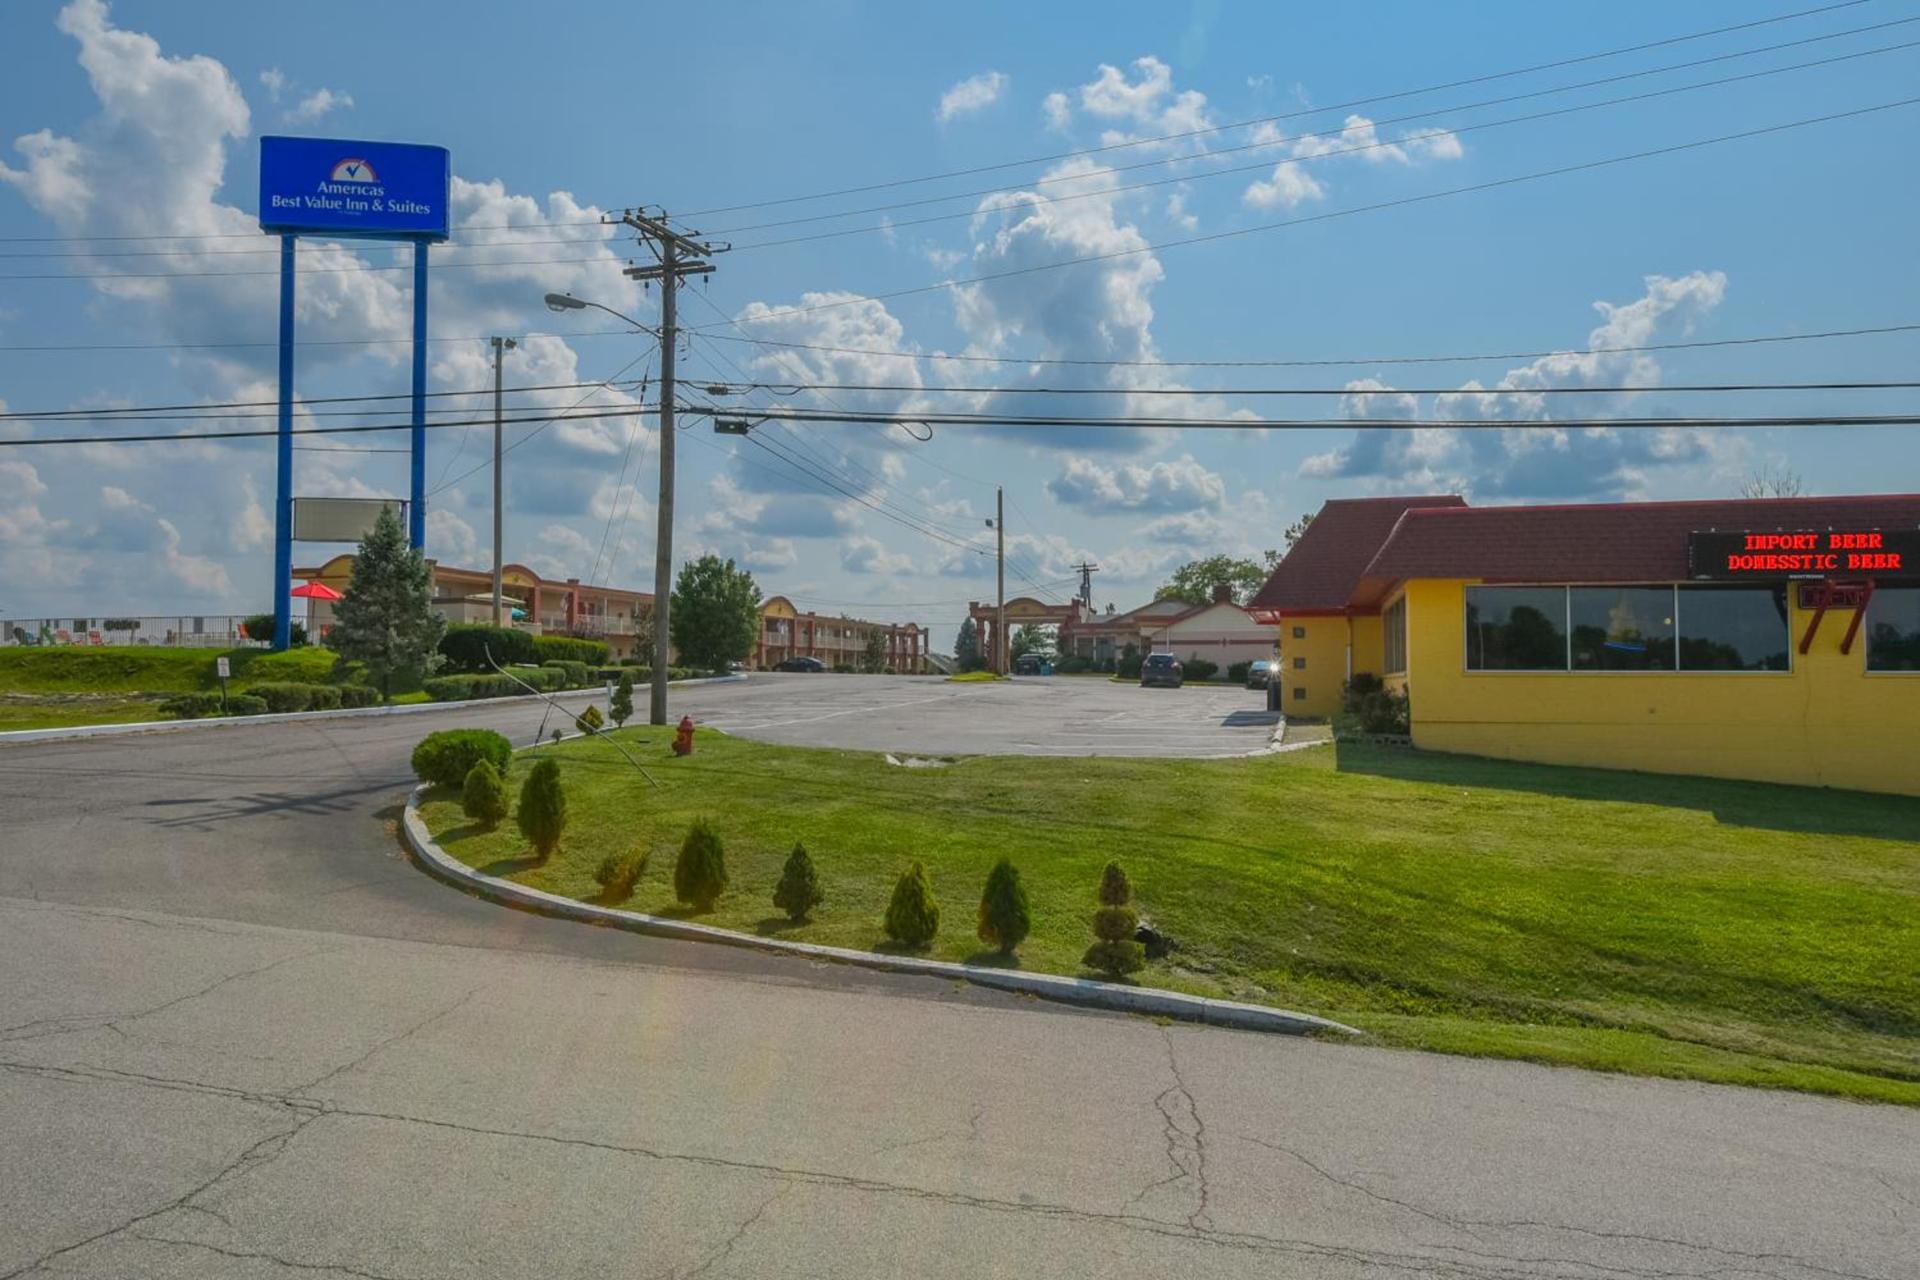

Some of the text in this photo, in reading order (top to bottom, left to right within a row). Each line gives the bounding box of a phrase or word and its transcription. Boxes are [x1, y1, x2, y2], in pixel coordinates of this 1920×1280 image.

[317, 181, 385, 196] Americas
[272, 195, 431, 214] Best Value Inn & Suites
[1745, 533, 1883, 550] IMPORT BEER
[1728, 553, 1901, 570] DOMESSTIC BEER
